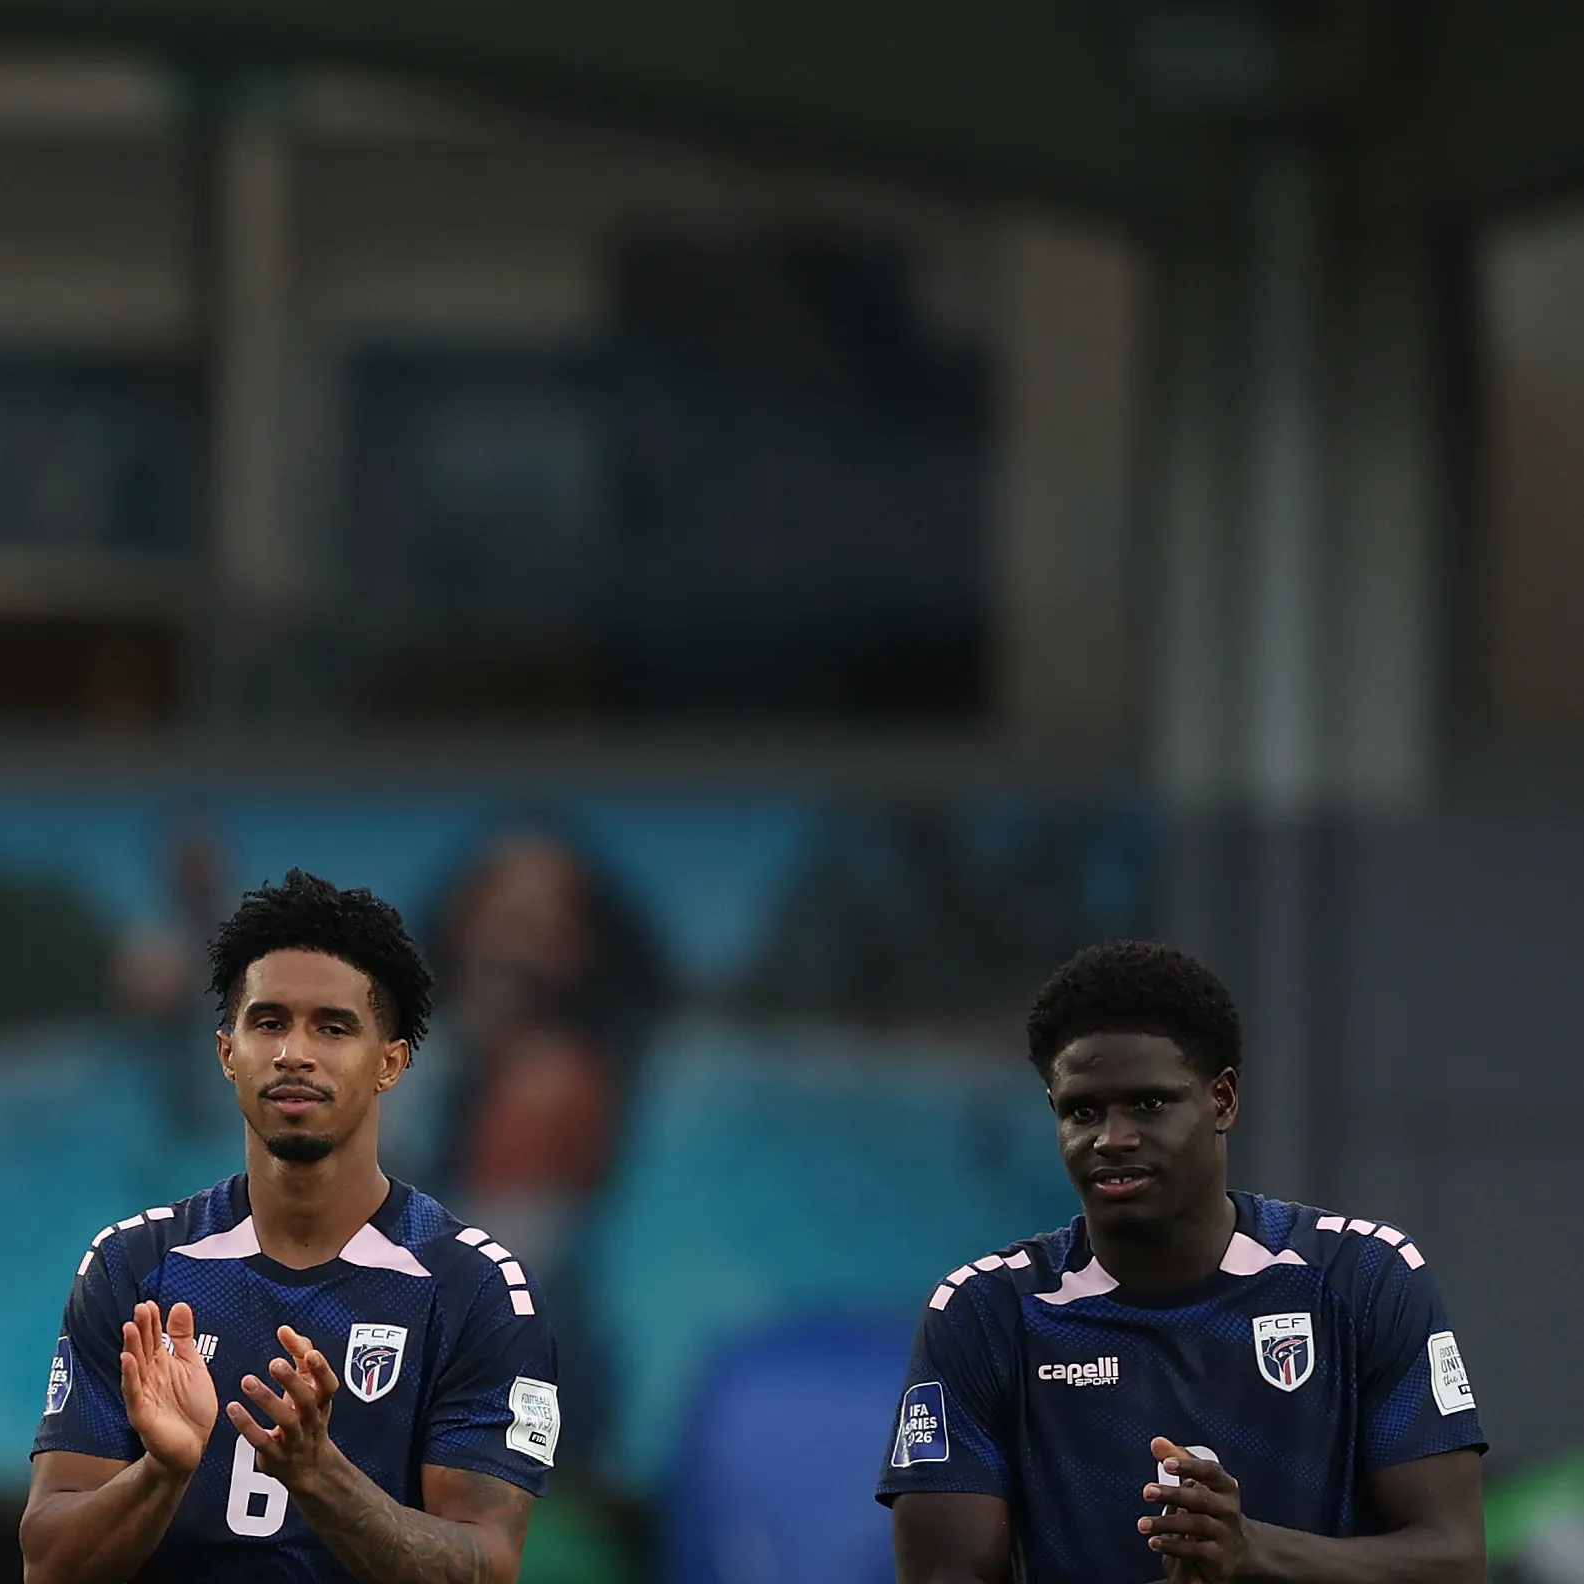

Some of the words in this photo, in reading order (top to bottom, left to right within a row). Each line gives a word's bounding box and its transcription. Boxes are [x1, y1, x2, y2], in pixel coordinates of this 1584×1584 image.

[1258, 1317, 1306, 1332] FCF
[356, 1328, 402, 1340] FCF
[1038, 1356, 1119, 1385] capelli
[1074, 1376, 1119, 1387] SPORT
[909, 1403, 929, 1418] IFA
[226, 1432, 289, 1538] 6
